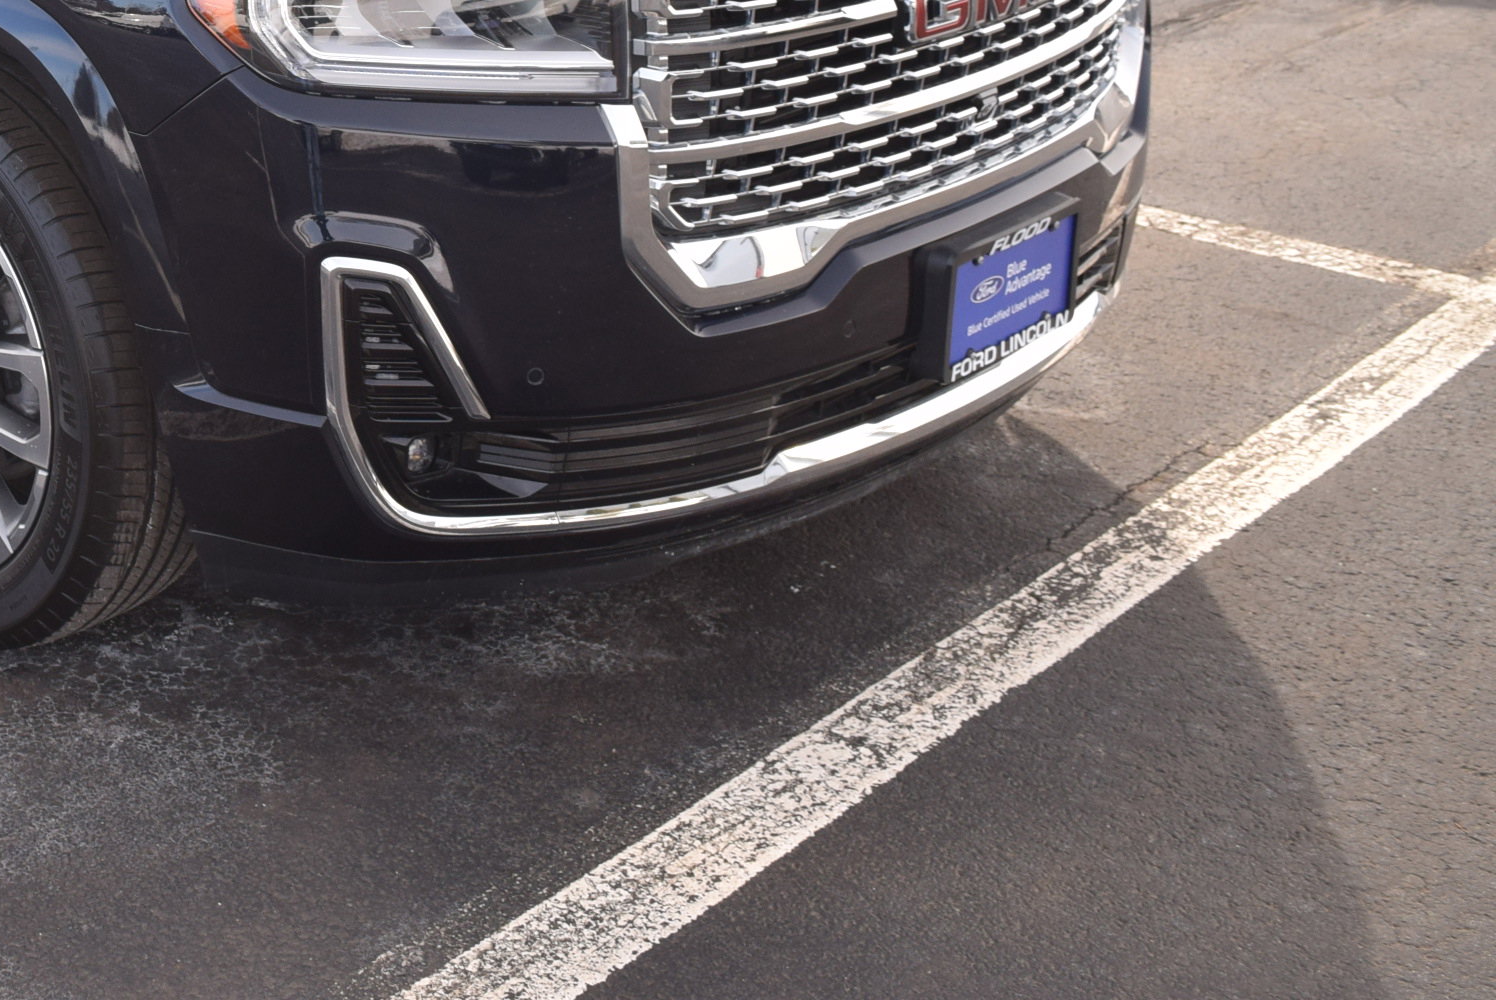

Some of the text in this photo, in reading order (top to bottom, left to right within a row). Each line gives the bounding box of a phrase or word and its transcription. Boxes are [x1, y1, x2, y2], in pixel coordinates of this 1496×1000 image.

[989, 217, 1052, 256] FLOOD
[1005, 263, 1052, 295] Advantage
[1006, 259, 1028, 279] Blue
[974, 279, 1000, 301] Ford
[967, 288, 1050, 337] Blue Certified Used Vehicle
[951, 310, 1069, 382] FORD LINCOLN
[53, 519, 67, 541] R
[43, 534, 61, 564] 20
